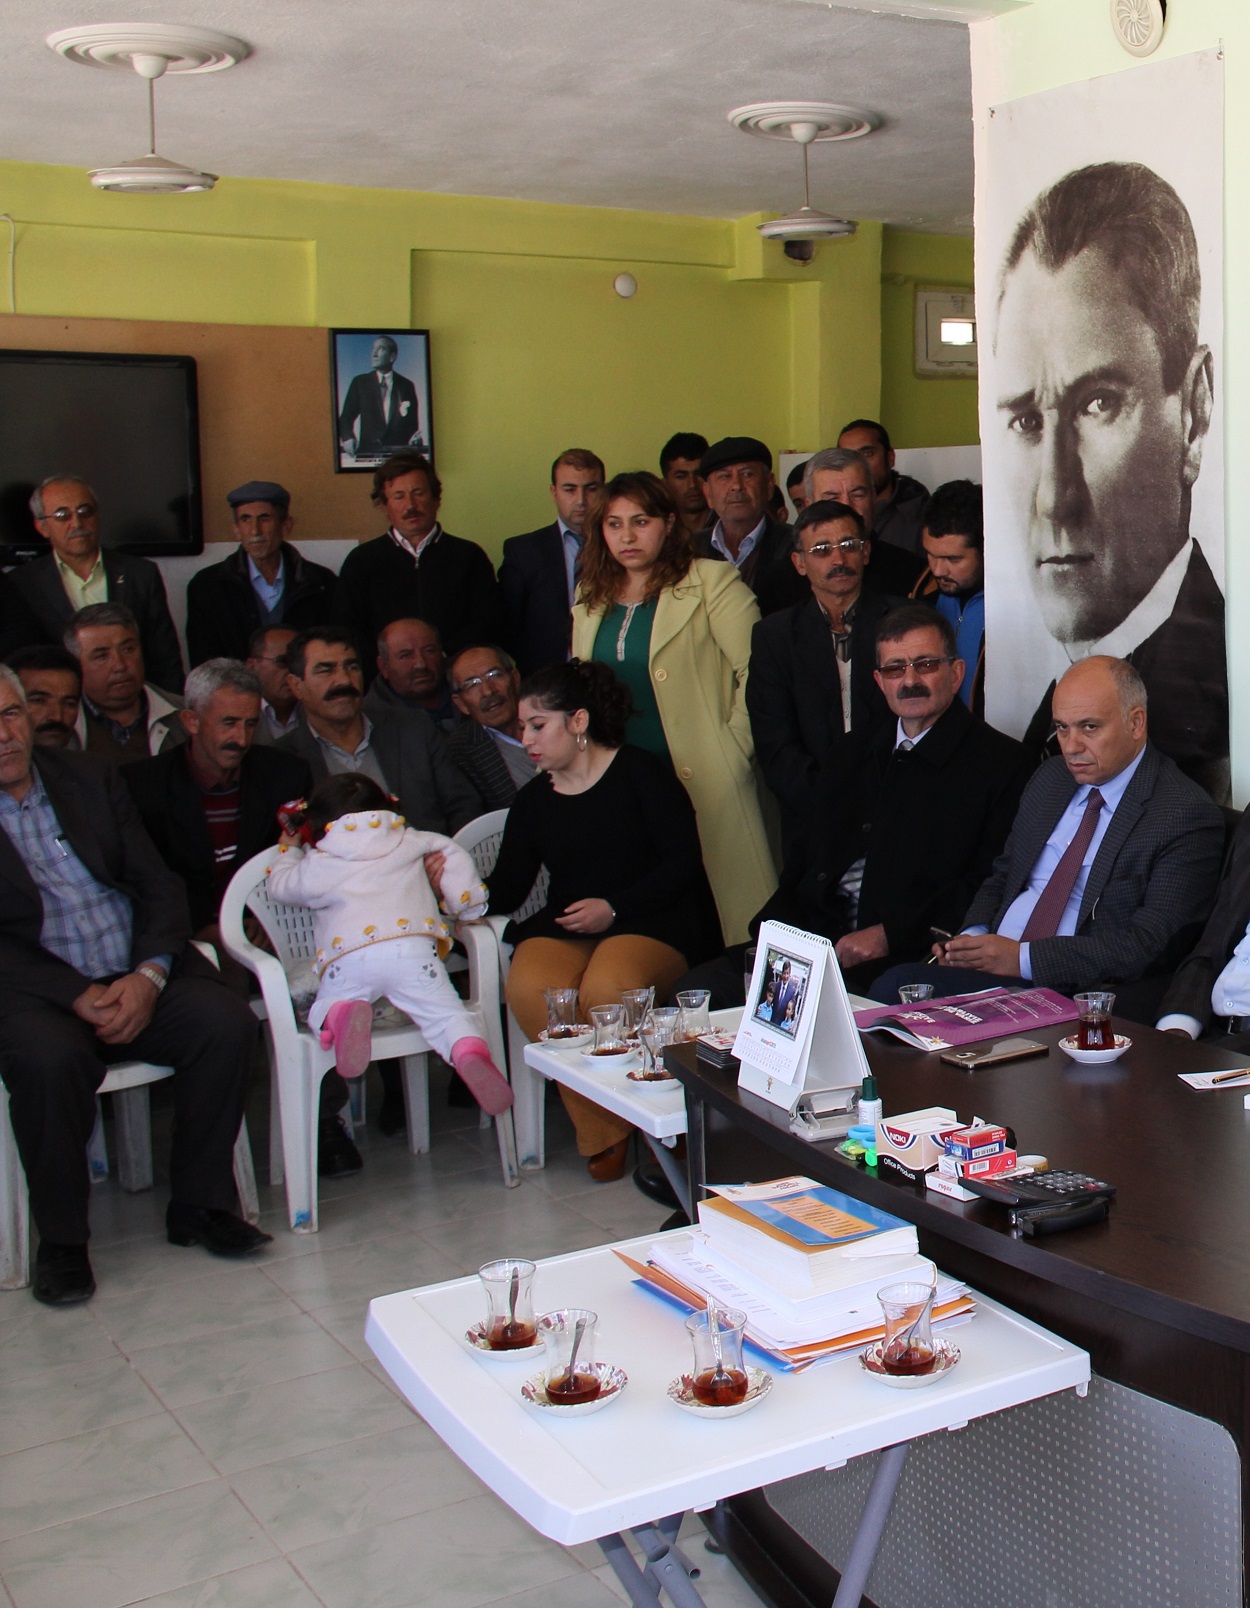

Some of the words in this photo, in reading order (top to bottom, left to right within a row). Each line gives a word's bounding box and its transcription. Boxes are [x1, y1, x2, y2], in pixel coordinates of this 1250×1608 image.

[889, 1132, 906, 1144] NOKI
[883, 1157, 896, 1169] Office
[896, 1163, 916, 1180] Products
